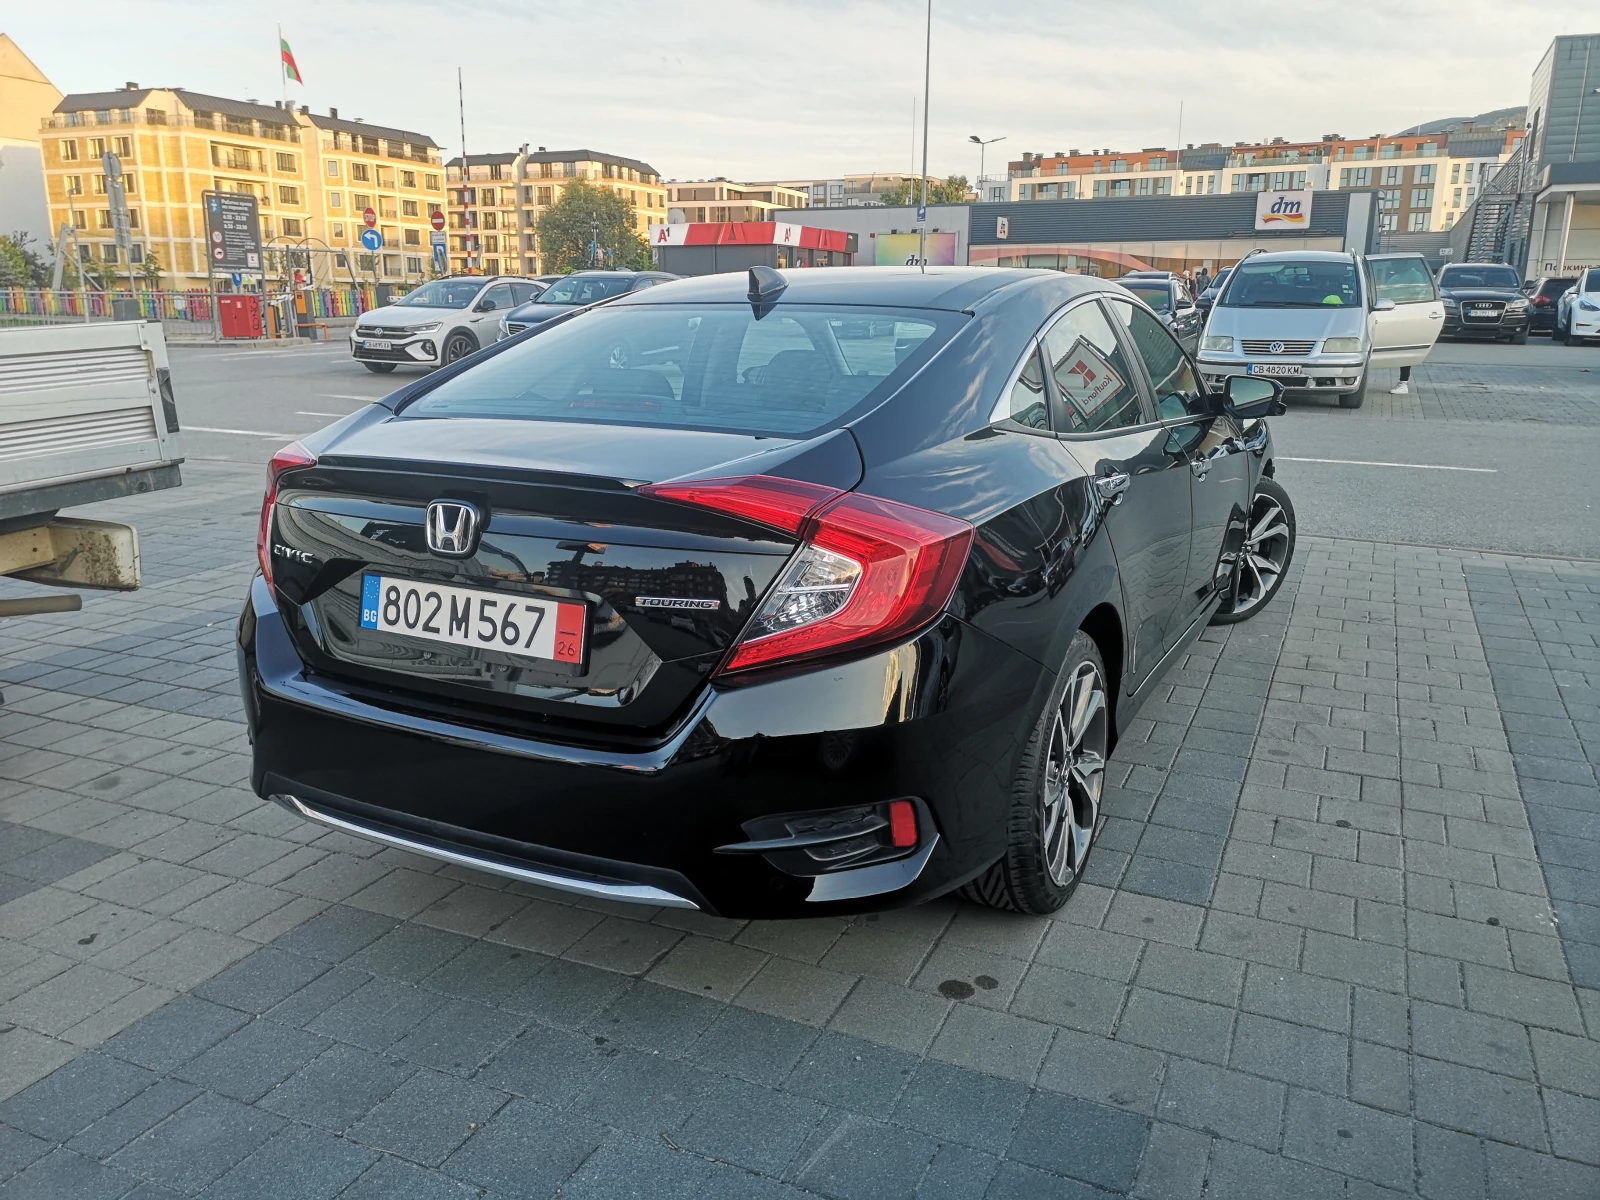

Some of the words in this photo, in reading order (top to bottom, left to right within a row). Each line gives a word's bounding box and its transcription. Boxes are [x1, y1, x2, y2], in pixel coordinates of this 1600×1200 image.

[1270, 196, 1301, 214] dm
[364, 213, 376, 222] STOP
[657, 226, 670, 243] A1
[784, 226, 791, 243] A1
[1253, 365, 1265, 374] CB
[1265, 365, 1287, 375] 4820
[1287, 366, 1300, 375] KM
[640, 598, 714, 609] TOURING
[363, 608, 377, 623] BG
[557, 641, 576, 657] 26
